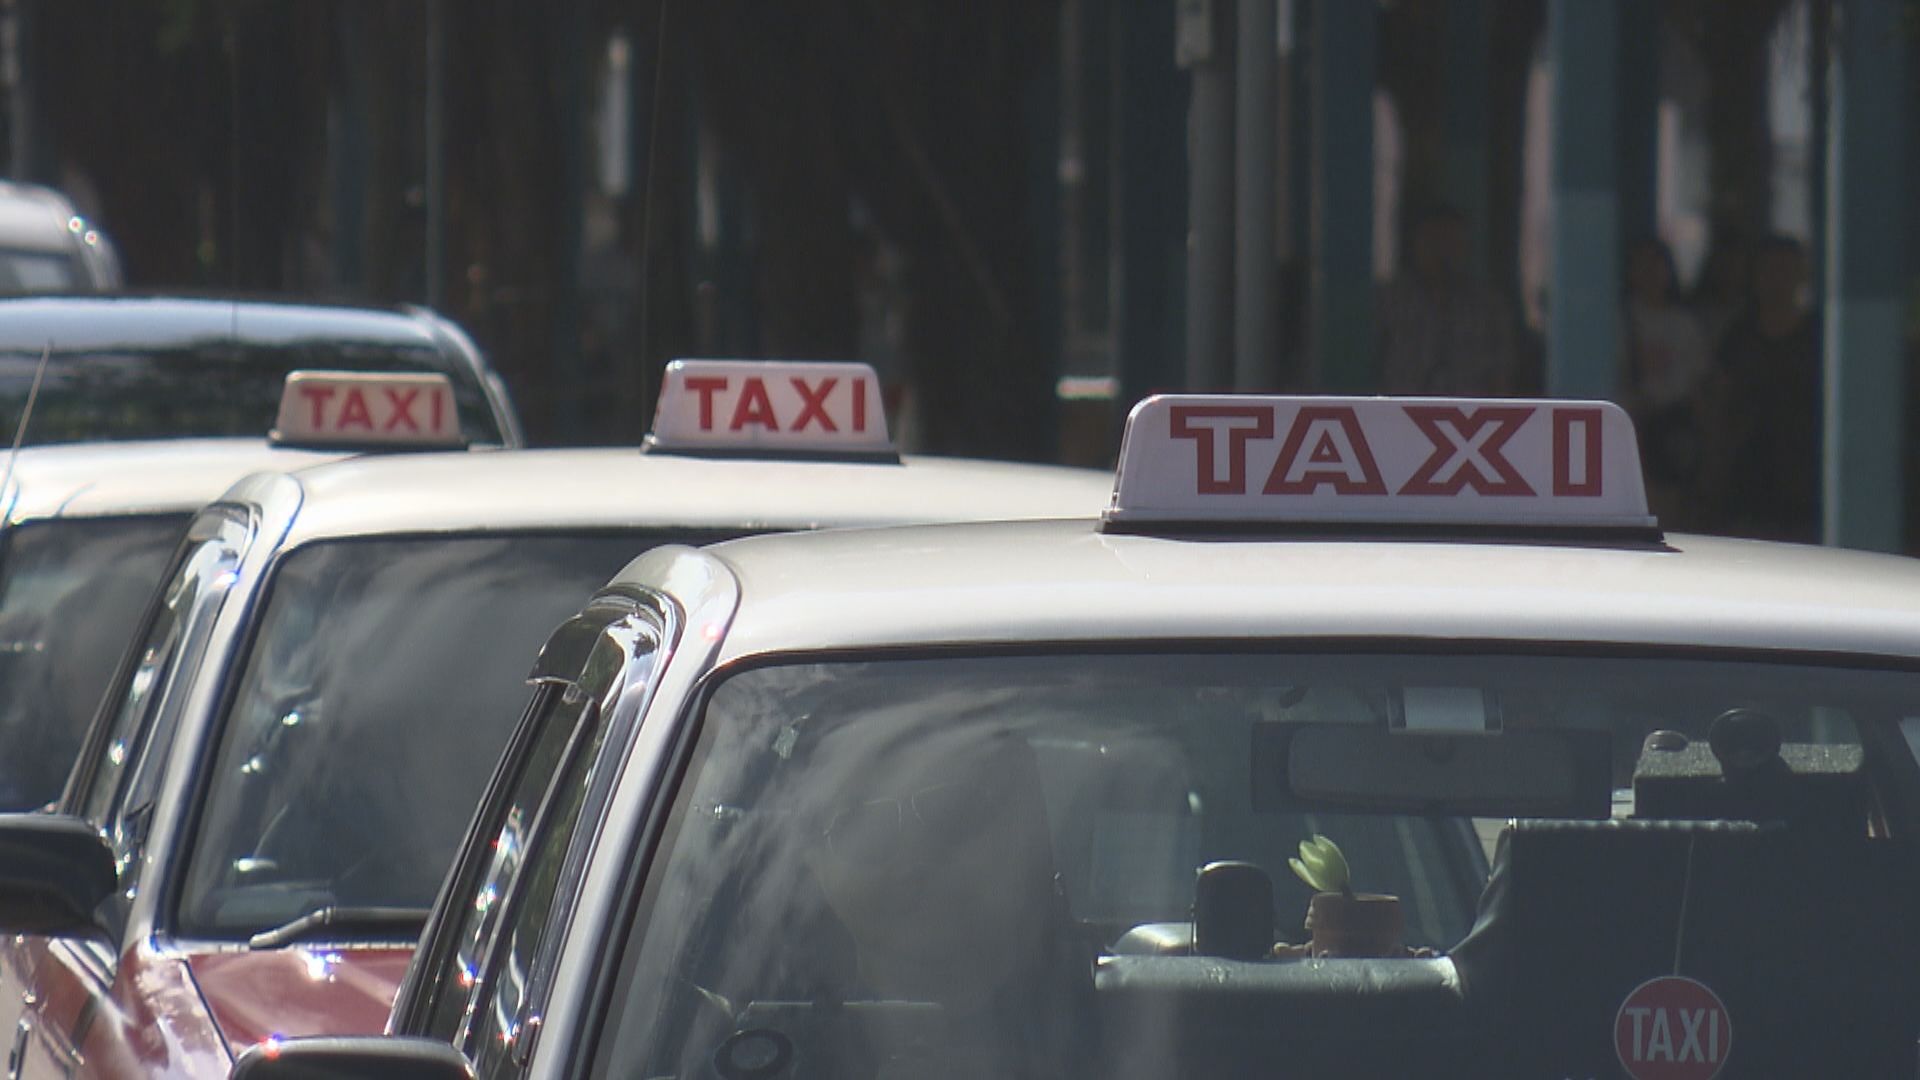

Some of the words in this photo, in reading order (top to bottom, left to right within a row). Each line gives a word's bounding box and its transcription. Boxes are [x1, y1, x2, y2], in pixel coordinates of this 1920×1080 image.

[300, 387, 444, 433] TAXI
[684, 376, 866, 432] TAXI
[1170, 406, 1603, 497] TAXI
[1625, 1007, 1720, 1064] TAXI
